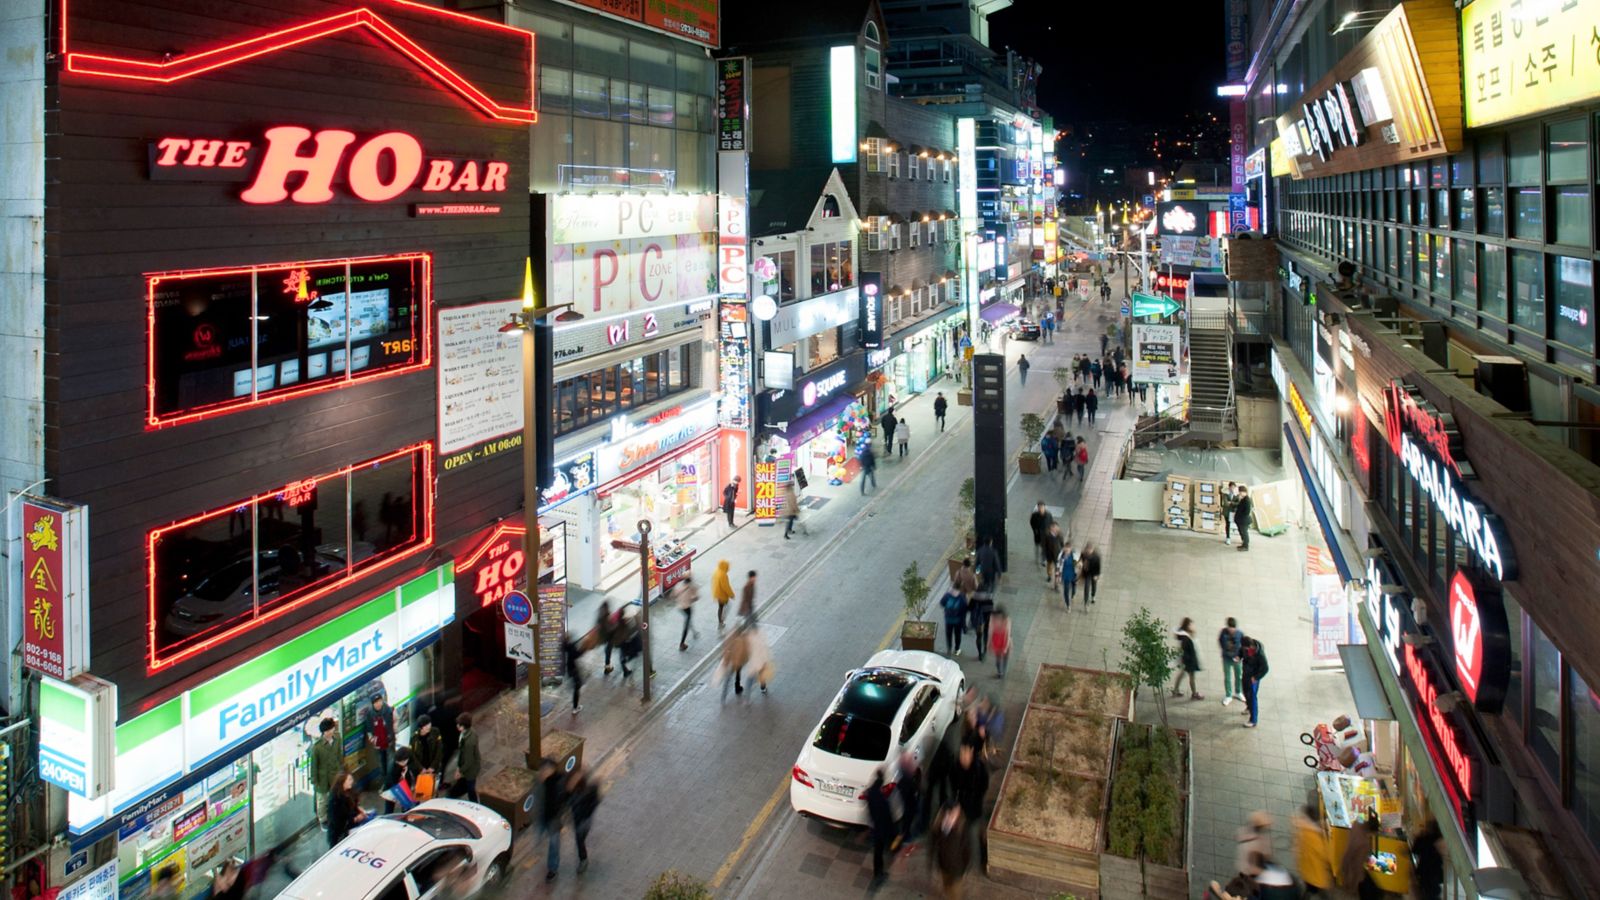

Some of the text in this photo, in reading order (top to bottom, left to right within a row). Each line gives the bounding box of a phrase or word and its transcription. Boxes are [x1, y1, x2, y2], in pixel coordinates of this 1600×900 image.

[1477, 66, 1501, 103] 호프
[1525, 43, 1557, 88] 소주
[721, 131, 742, 140] 노래
[721, 141, 743, 150] 타운
[157, 125, 509, 204] THE HO BAR
[418, 204, 501, 215] www.THEHOBAR.com
[1145, 196, 1153, 204] P
[721, 248, 745, 283] PC
[866, 296, 876, 332] SQUARE
[816, 369, 847, 396] SQUARE
[444, 450, 474, 470] OPEN
[483, 443, 497, 457] AM
[498, 435, 522, 452] 06:00
[756, 464, 775, 473] SALE
[756, 473, 775, 482] SALE
[756, 483, 775, 499] 20
[756, 499, 775, 508] SALE
[756, 508, 775, 517] SALE
[488, 541, 510, 560] THE
[475, 551, 524, 594] HO
[29, 556, 58, 640] 金龍
[482, 579, 514, 608] BAR
[26, 643, 62, 664] 802-9168
[217, 629, 384, 741] FamilyMart
[121, 792, 168, 824] FamilyMart
[72, 860, 82, 870] 19
[339, 847, 388, 869] KT&G
